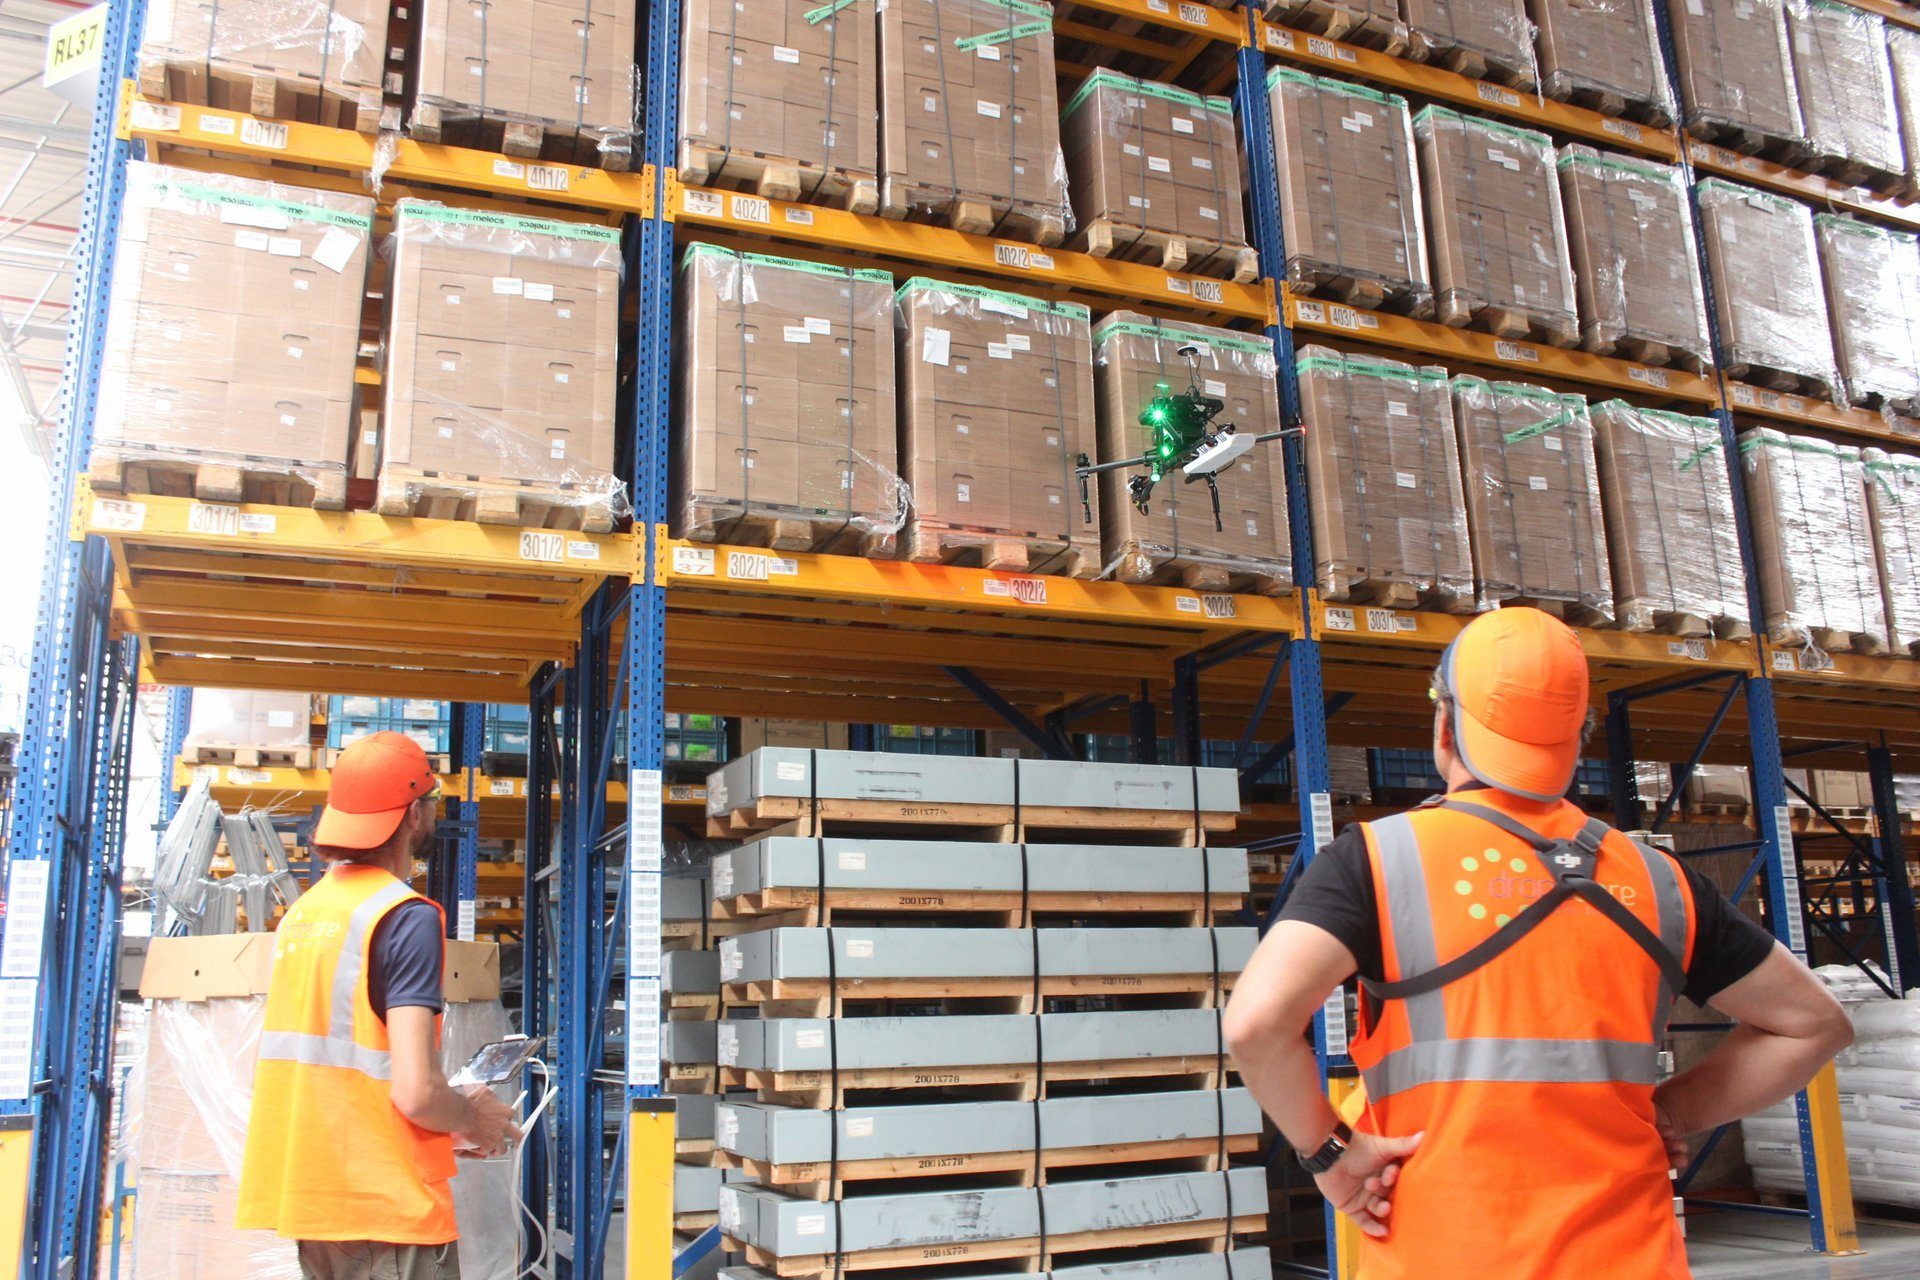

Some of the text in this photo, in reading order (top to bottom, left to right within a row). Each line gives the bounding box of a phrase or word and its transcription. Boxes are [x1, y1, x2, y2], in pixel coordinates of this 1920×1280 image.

[1181, 5, 1208, 24] 502/3
[55, 24, 98, 66] RL37
[246, 121, 287, 147] 401/1
[530, 166, 567, 189] 401/2
[473, 215, 505, 225] melecs
[735, 198, 768, 222] 402/1
[335, 214, 368, 228] melecs
[580, 227, 612, 239] melecs
[998, 247, 1028, 267] 402/2
[1195, 281, 1222, 301] 402/3
[1301, 312, 1321, 321] 37
[1333, 307, 1358, 329] 403/1
[103, 502, 142, 515] RL
[194, 506, 237, 535] 301/1
[523, 533, 562, 559] 301/2
[679, 550, 711, 560] RL
[678, 563, 707, 572] 37
[731, 553, 767, 578] 302/1
[1013, 579, 1046, 602] 302/2
[1205, 596, 1235, 616] 302/3
[1329, 609, 1352, 618] RL
[1369, 610, 1396, 631] 303/1
[1554, 853, 1582, 868] dji
[914, 1075, 960, 1084] 2001X778
